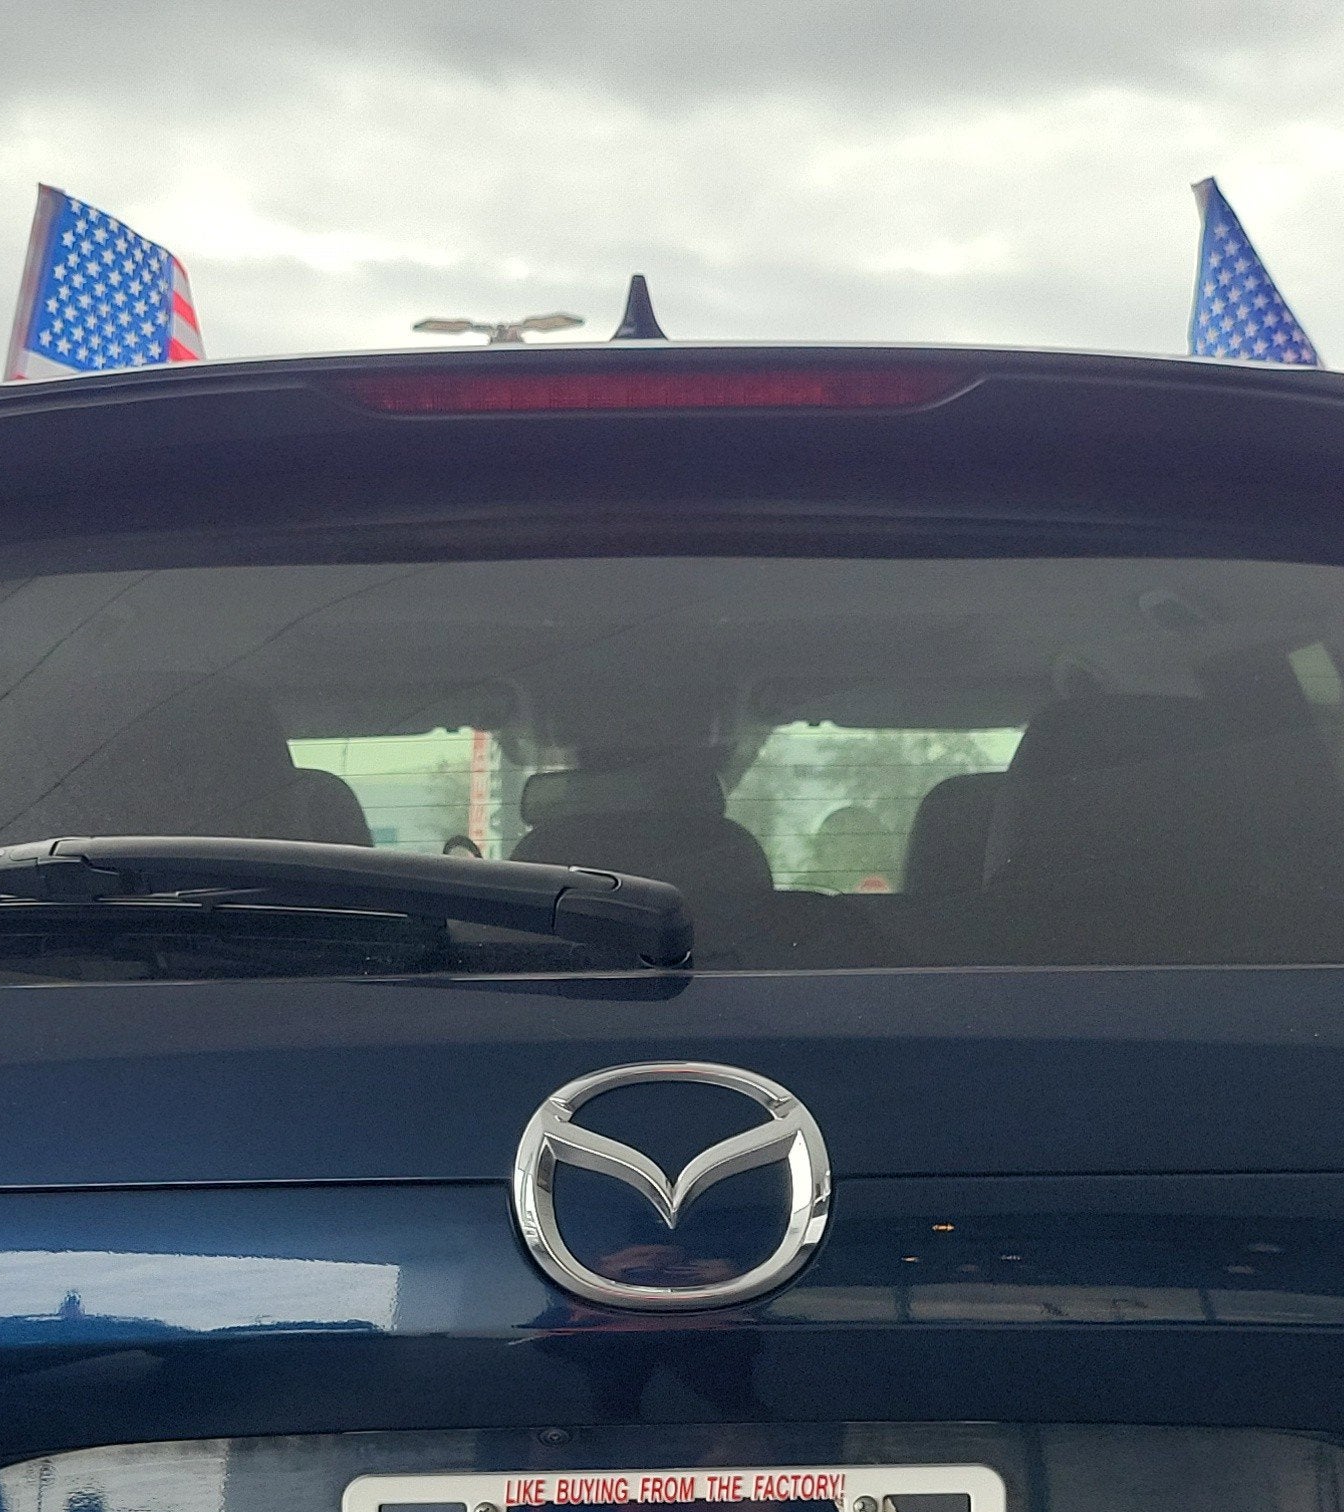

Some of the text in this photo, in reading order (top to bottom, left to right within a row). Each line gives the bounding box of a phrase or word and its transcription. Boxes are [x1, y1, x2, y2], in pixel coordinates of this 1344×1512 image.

[506, 1474, 846, 1503] LIKE BUYING FROM THE FACTORY!
